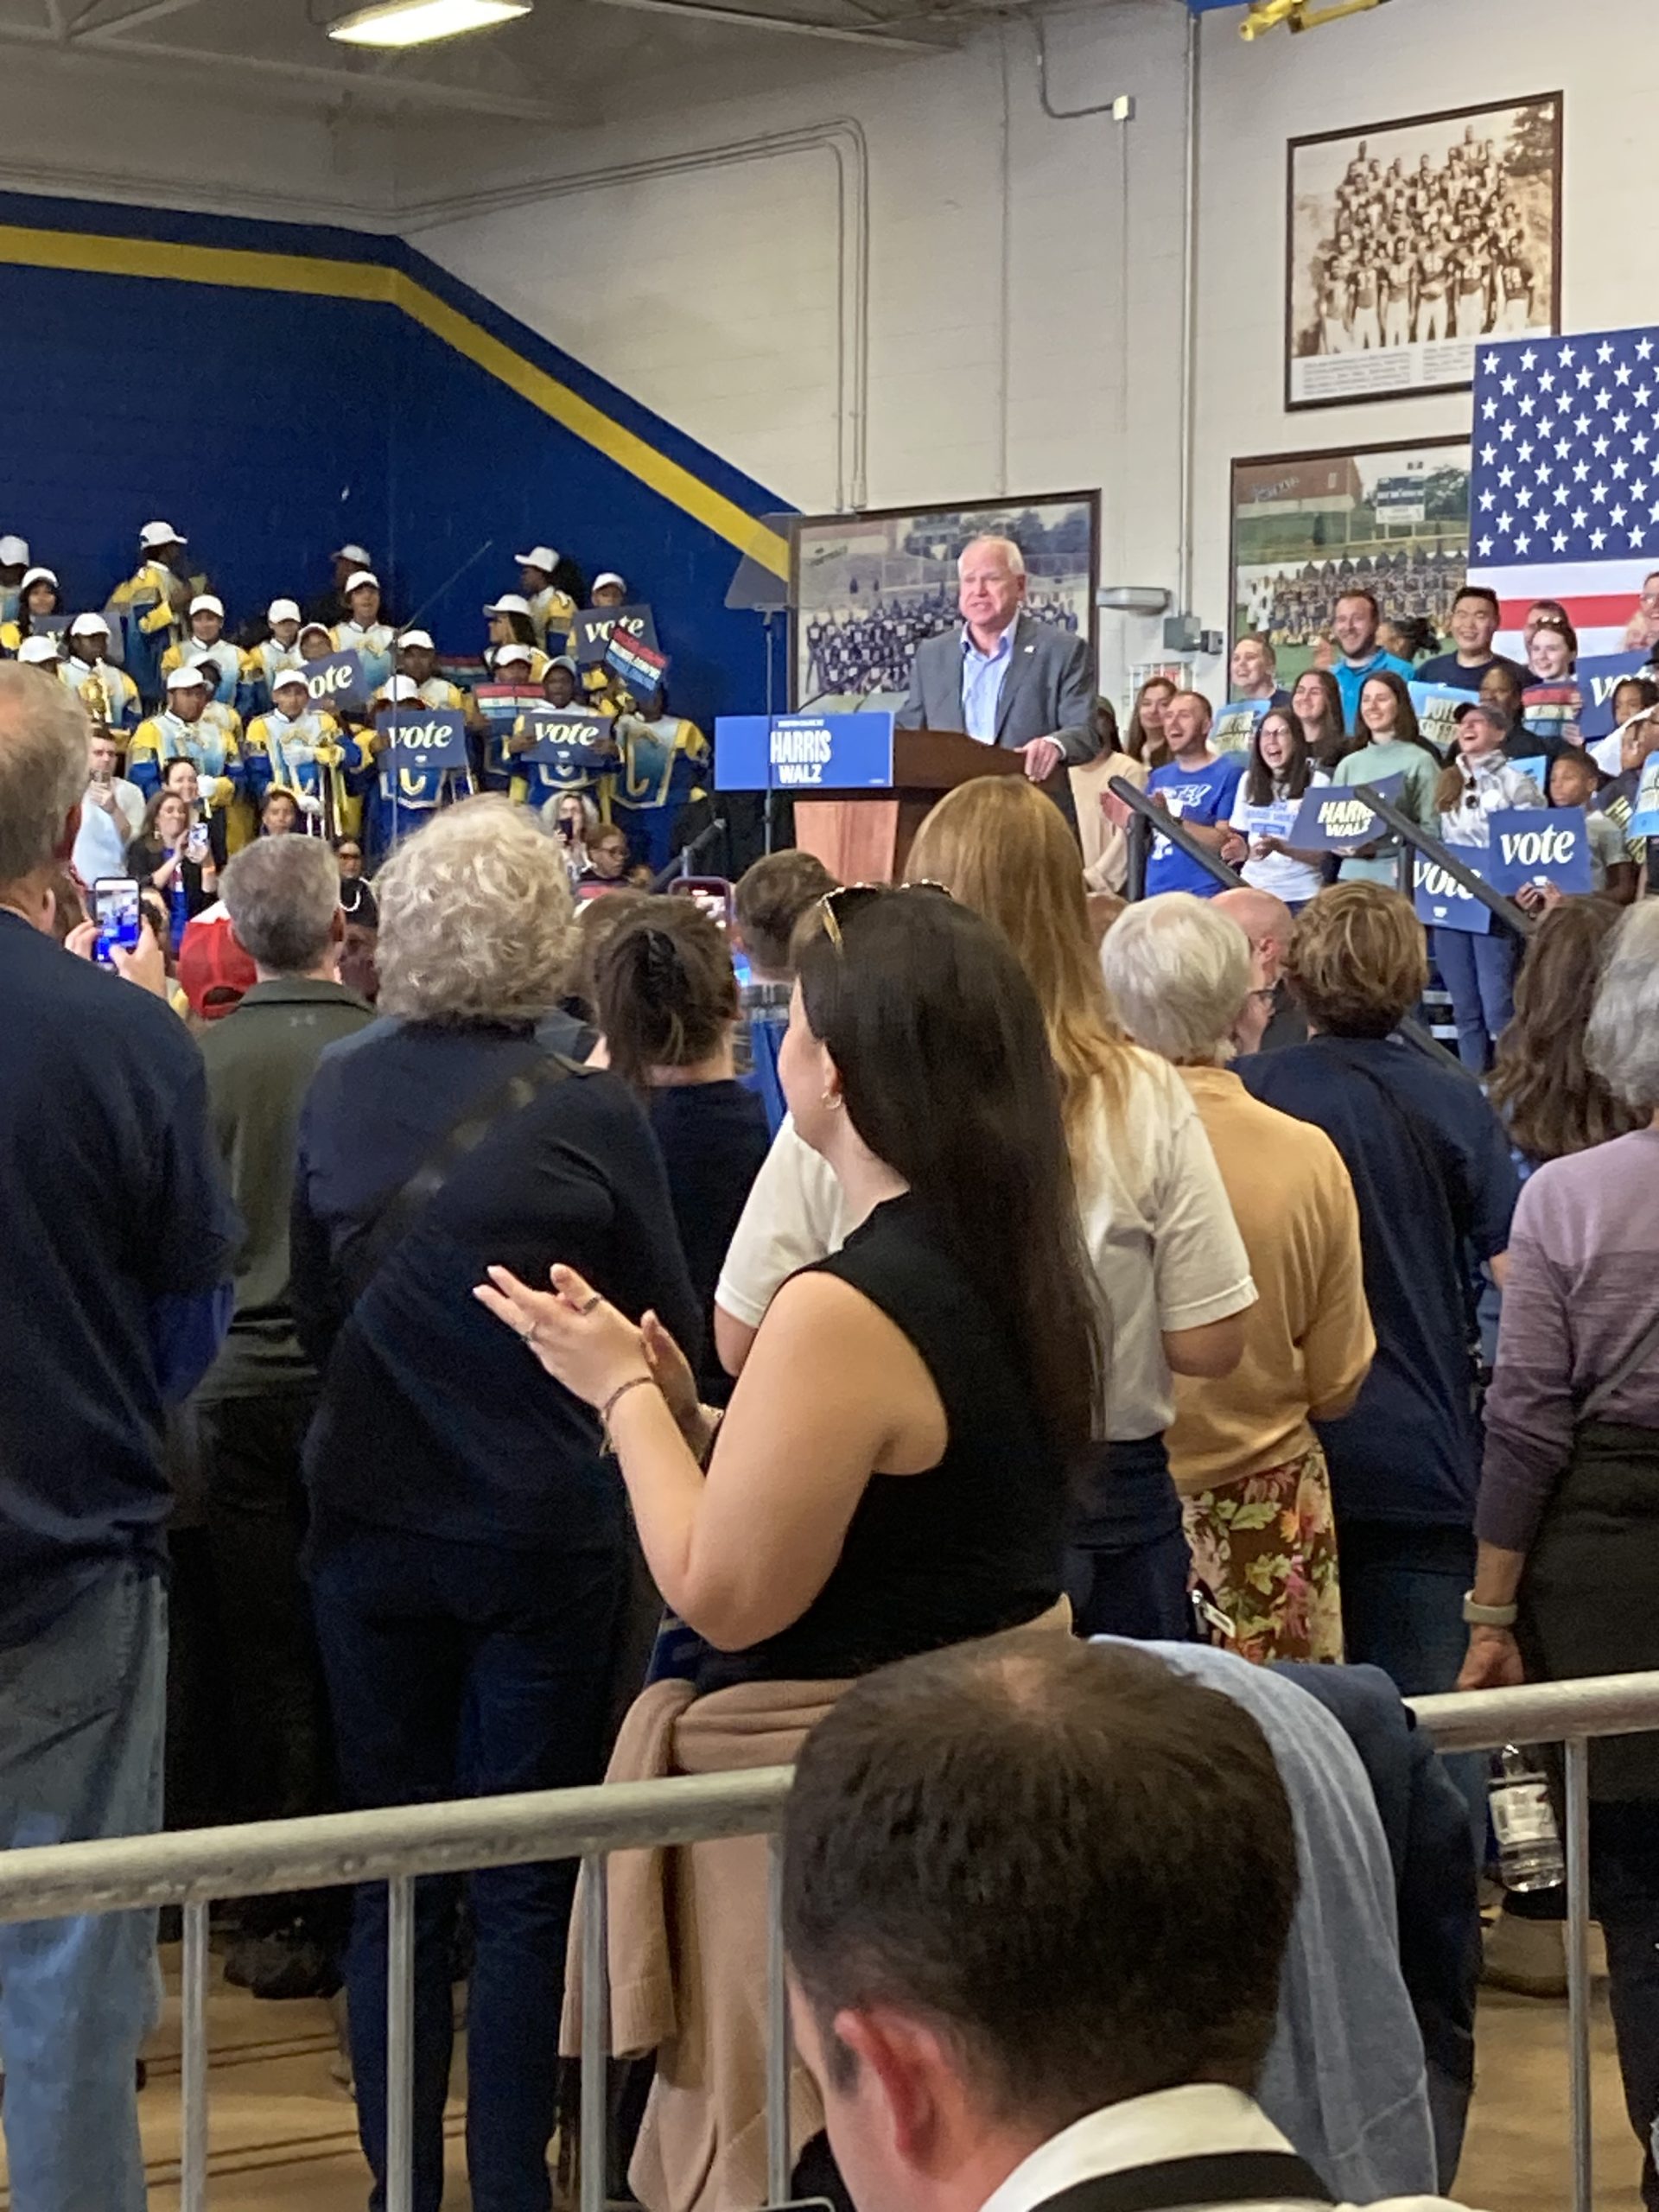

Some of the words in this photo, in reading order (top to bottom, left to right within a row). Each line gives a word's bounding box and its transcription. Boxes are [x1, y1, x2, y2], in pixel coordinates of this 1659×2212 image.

[308, 664, 353, 699] ote
[388, 721, 453, 749] vote
[534, 722, 600, 746] vote
[770, 730, 832, 764] HARRIS
[779, 764, 823, 784] WALZ
[1500, 823, 1576, 866] vote
